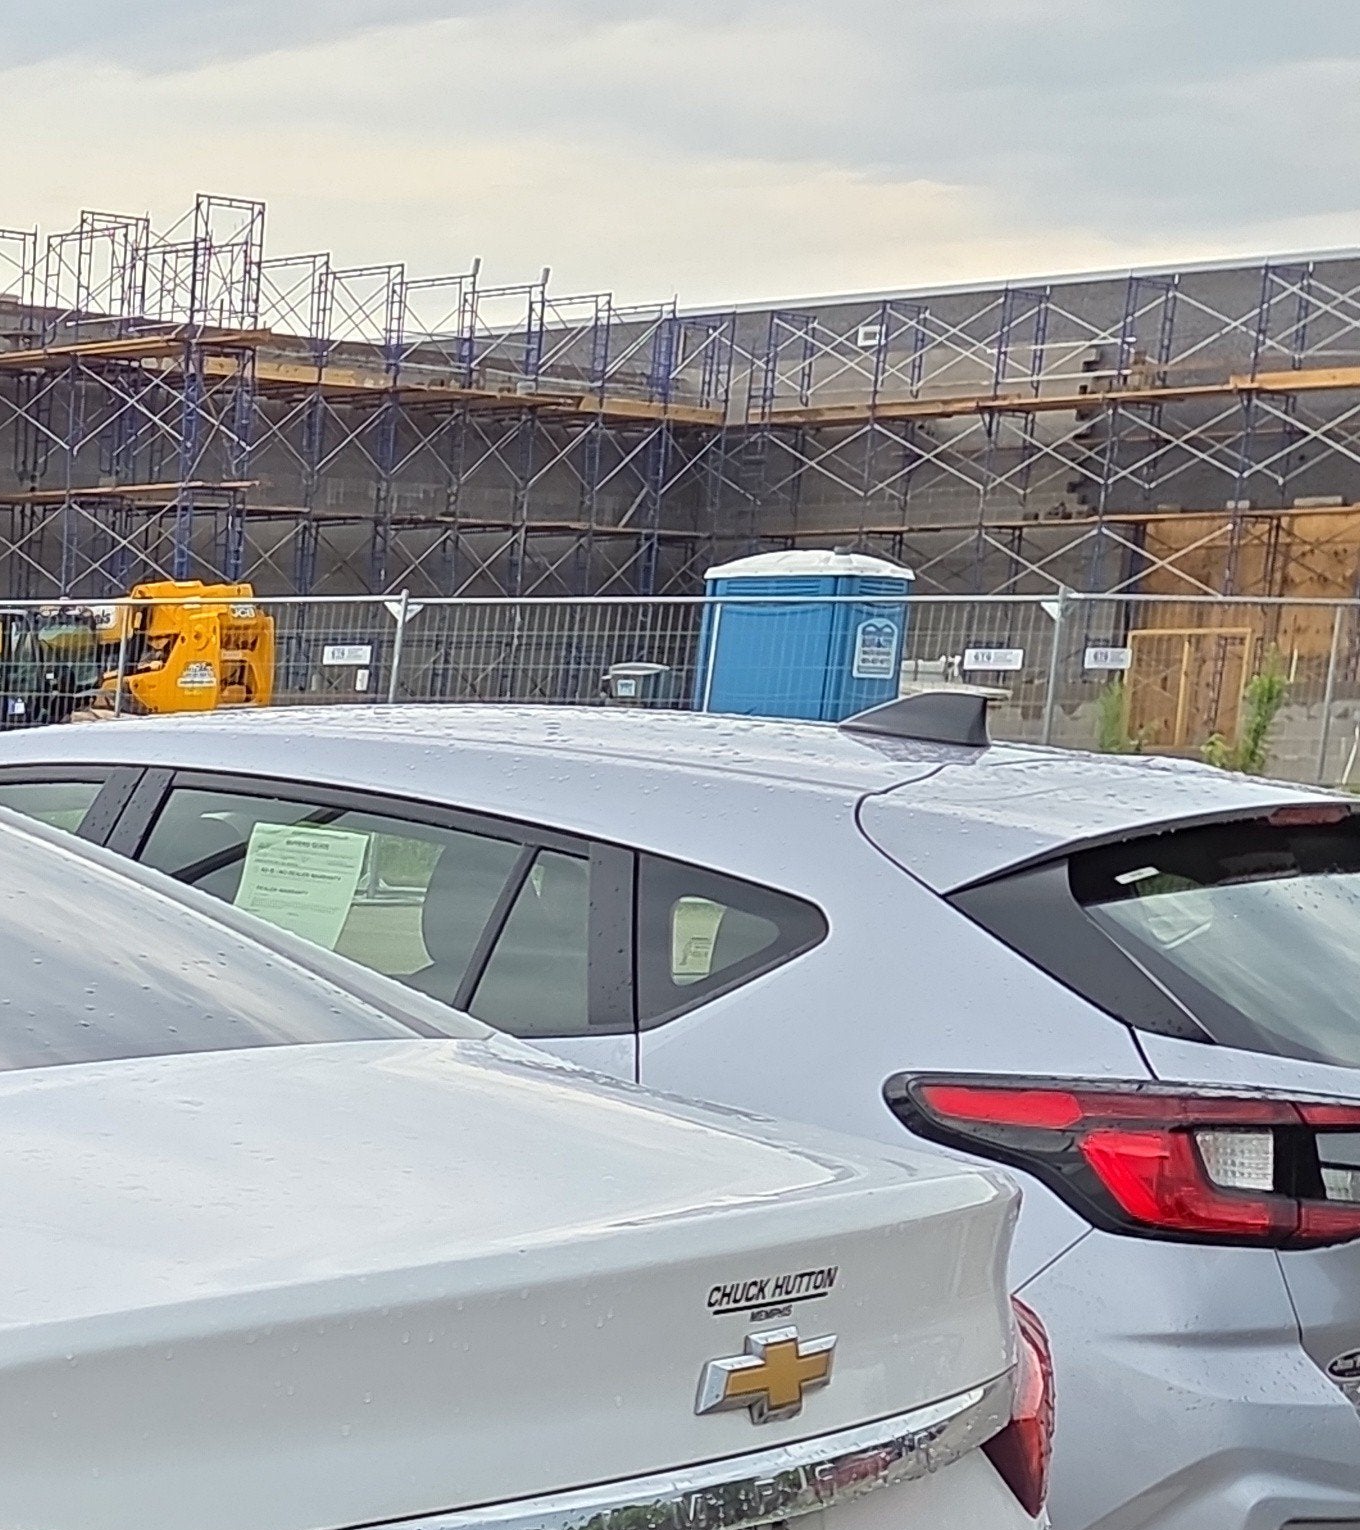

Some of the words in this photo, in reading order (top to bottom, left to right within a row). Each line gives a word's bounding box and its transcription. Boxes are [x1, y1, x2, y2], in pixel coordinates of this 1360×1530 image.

[707, 1277, 770, 1308] CHUCK
[771, 1265, 839, 1298] HUTTON
[749, 1304, 794, 1323] MEMPHIS
